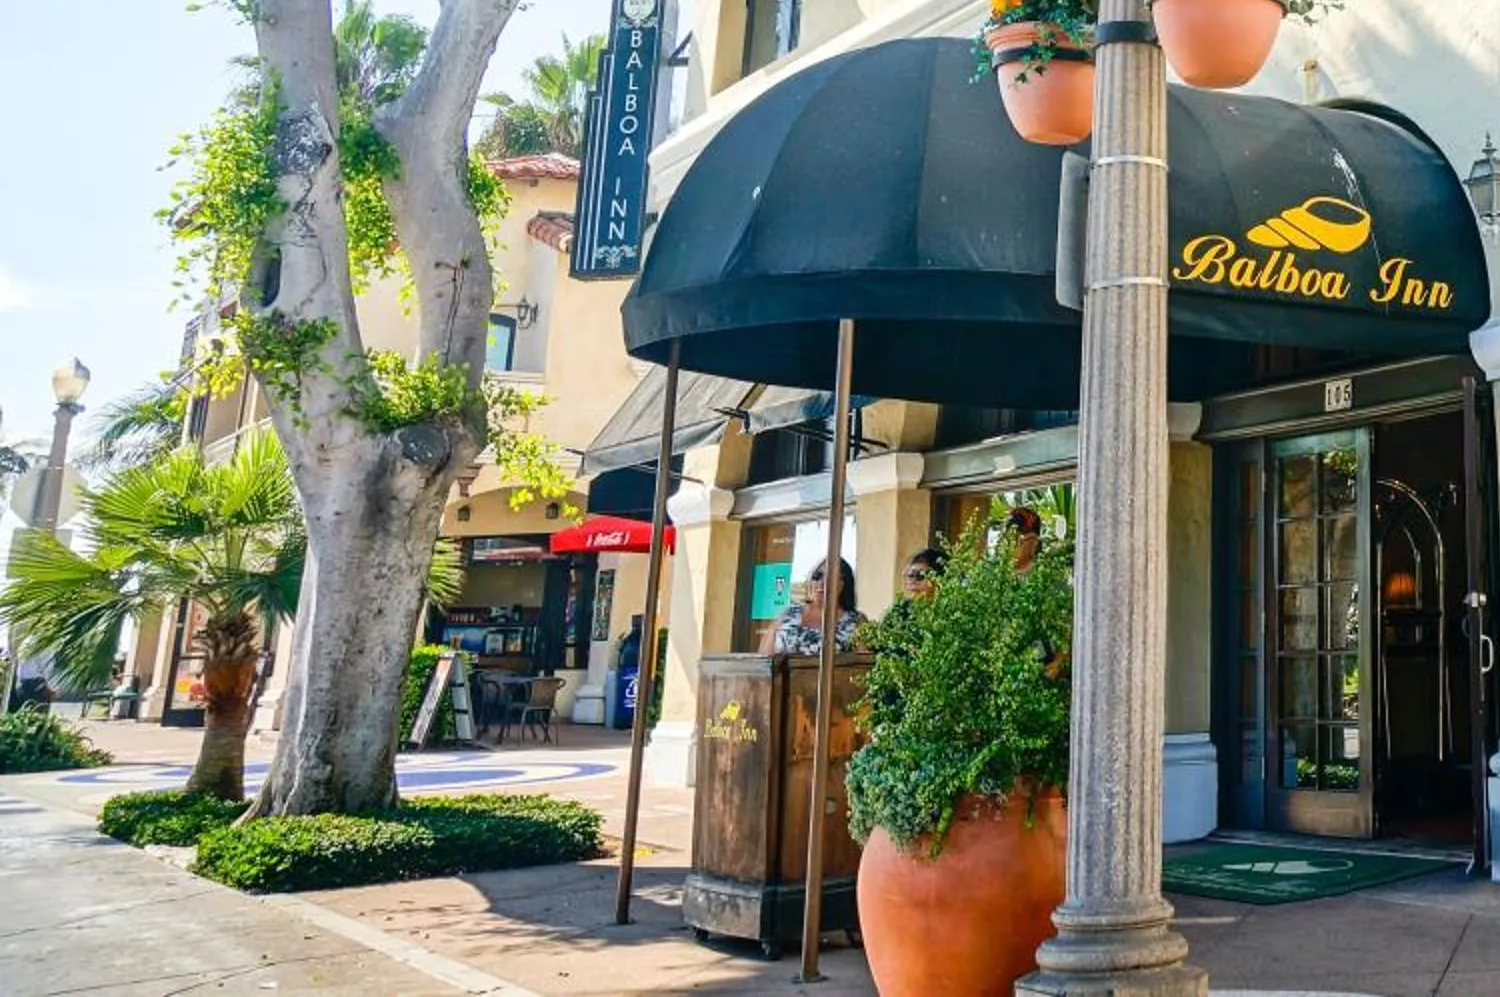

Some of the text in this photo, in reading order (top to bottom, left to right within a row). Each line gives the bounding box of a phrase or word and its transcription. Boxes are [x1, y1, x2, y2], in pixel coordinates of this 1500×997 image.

[618, 29, 643, 156] BALBOA
[608, 176, 628, 240] INN
[1172, 234, 1454, 309] Balboa Inn
[1327, 384, 1352, 406] 105
